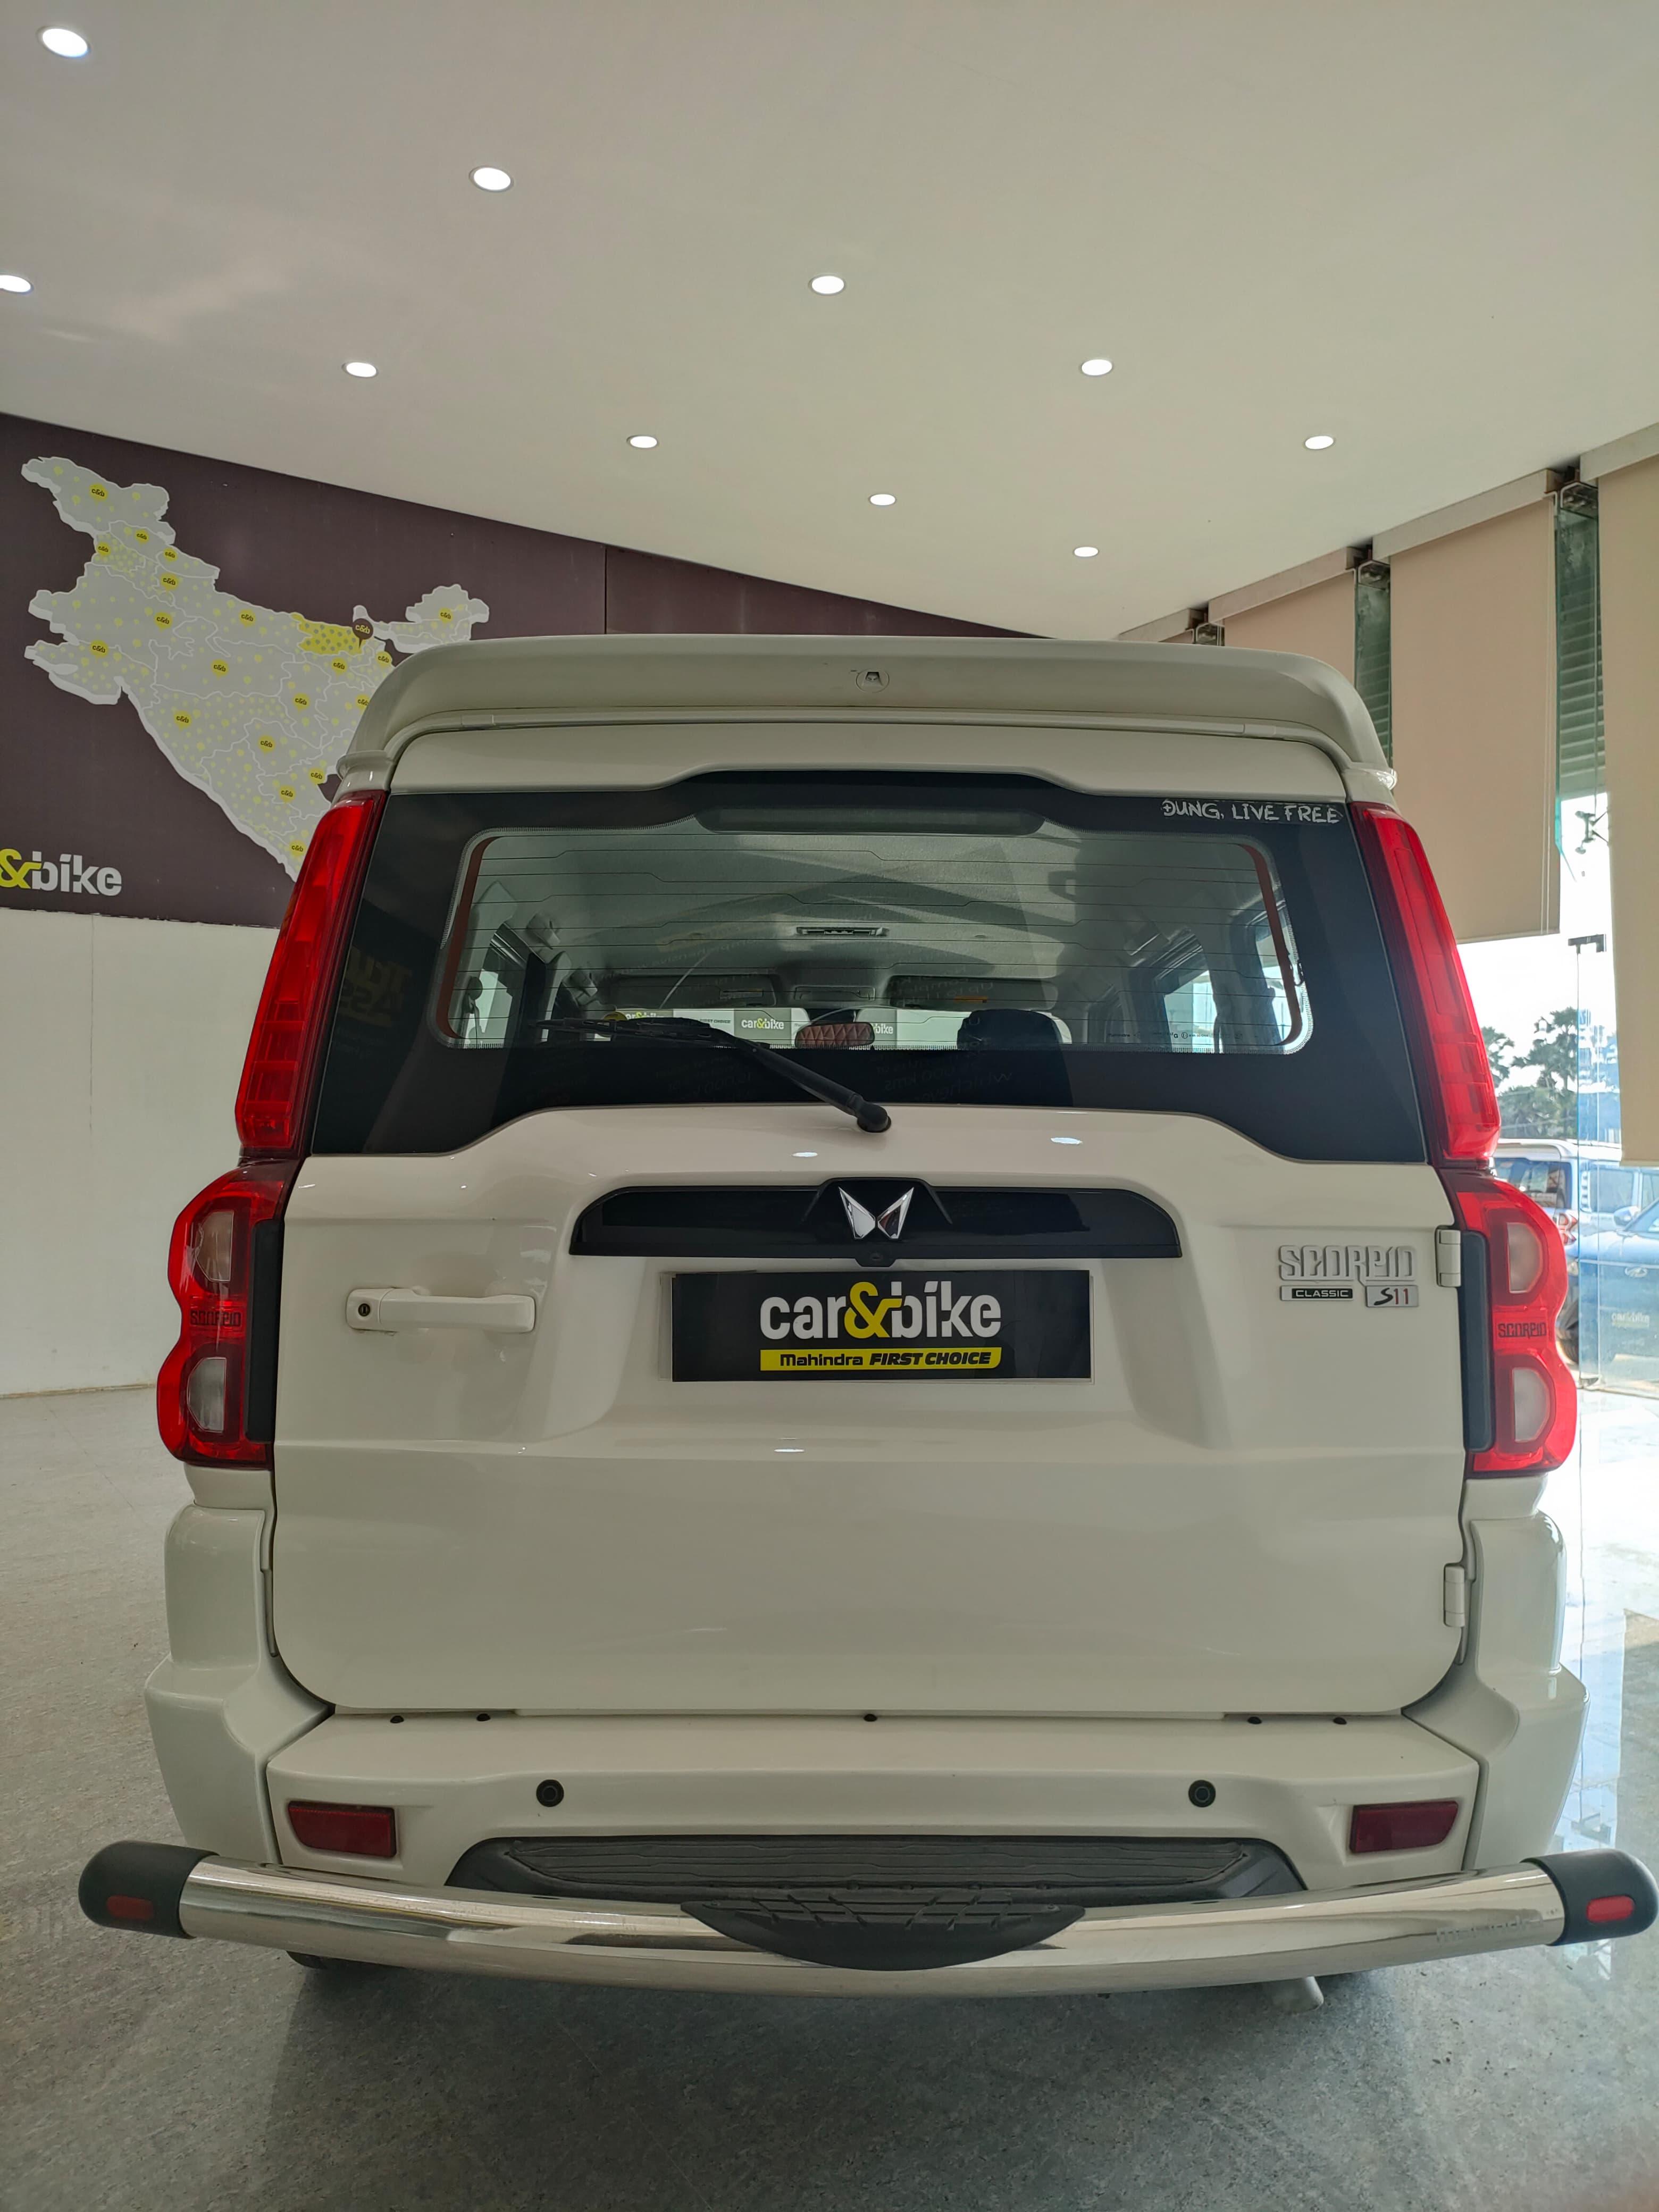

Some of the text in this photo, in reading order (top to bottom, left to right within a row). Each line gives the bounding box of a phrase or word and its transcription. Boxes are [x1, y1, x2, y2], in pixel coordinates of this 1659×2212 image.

[1231, 803, 1279, 820] LIVE
[1284, 805, 1340, 824] FREE
[741, 1017, 785, 1030] car&bike
[873, 1023, 894, 1034] bike
[1278, 1245, 1417, 1282] SCORPIO
[1295, 1289, 1349, 1298] CLASSIC
[1373, 1287, 1409, 1306] S11
[759, 1280, 1002, 1340] car&bike
[1497, 1322, 1547, 1338] SCORPIO
[780, 1351, 992, 1367] Mahindra FIRST CHOICE
